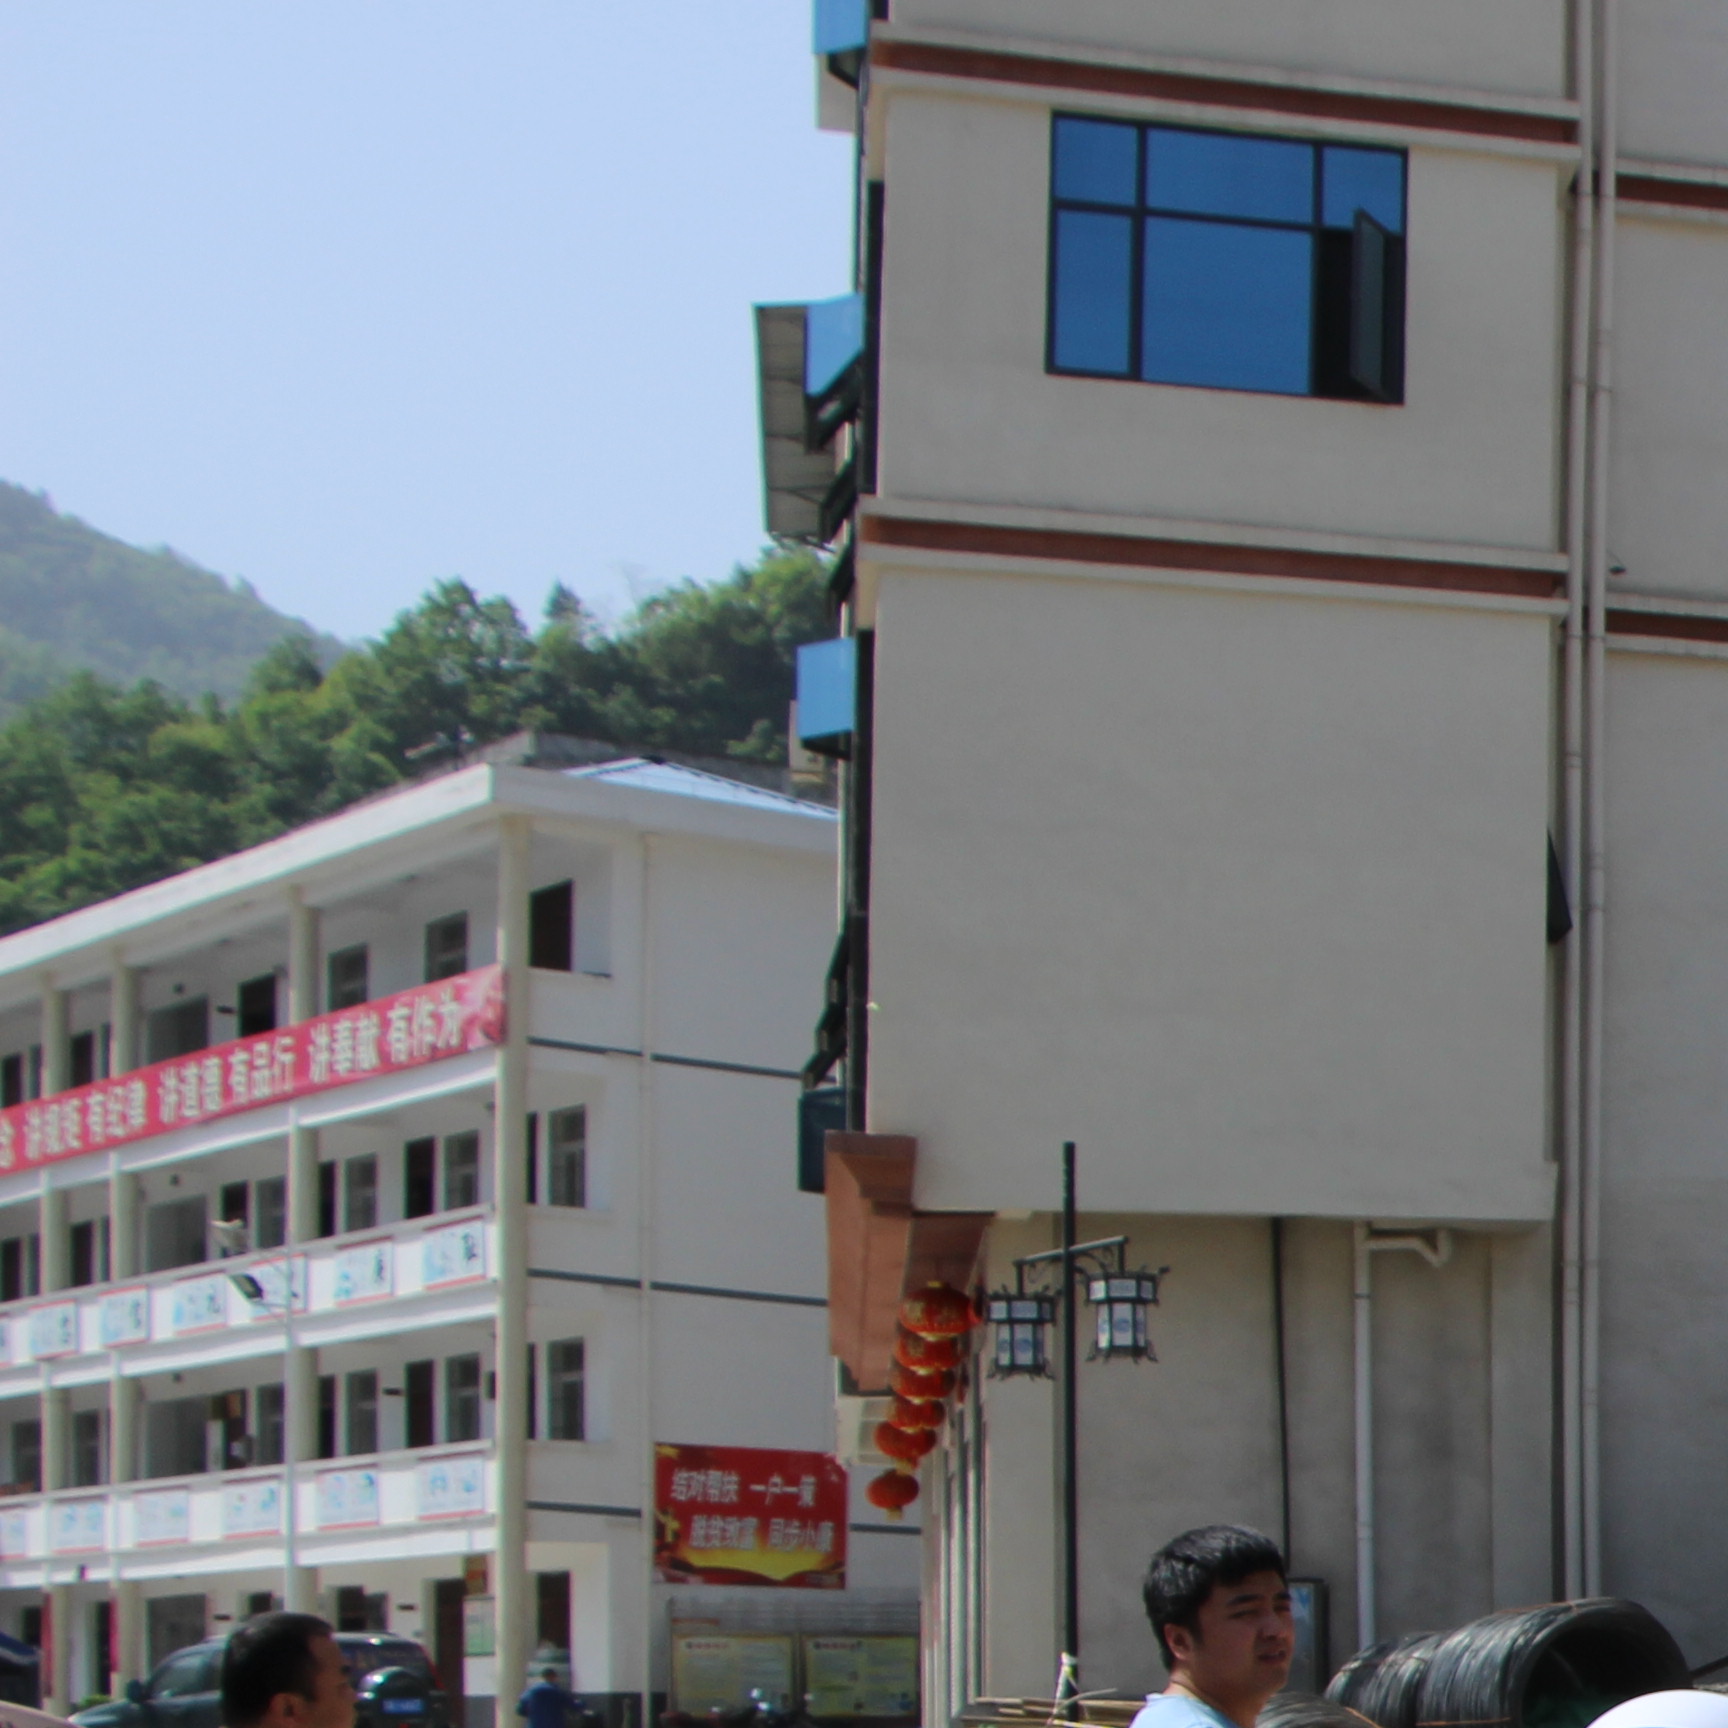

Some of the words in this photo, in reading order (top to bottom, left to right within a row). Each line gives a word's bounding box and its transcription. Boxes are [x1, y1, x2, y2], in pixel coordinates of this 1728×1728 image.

[308, 1011, 381, 1084] 讲奉献
[386, 987, 462, 1063] 有作为
